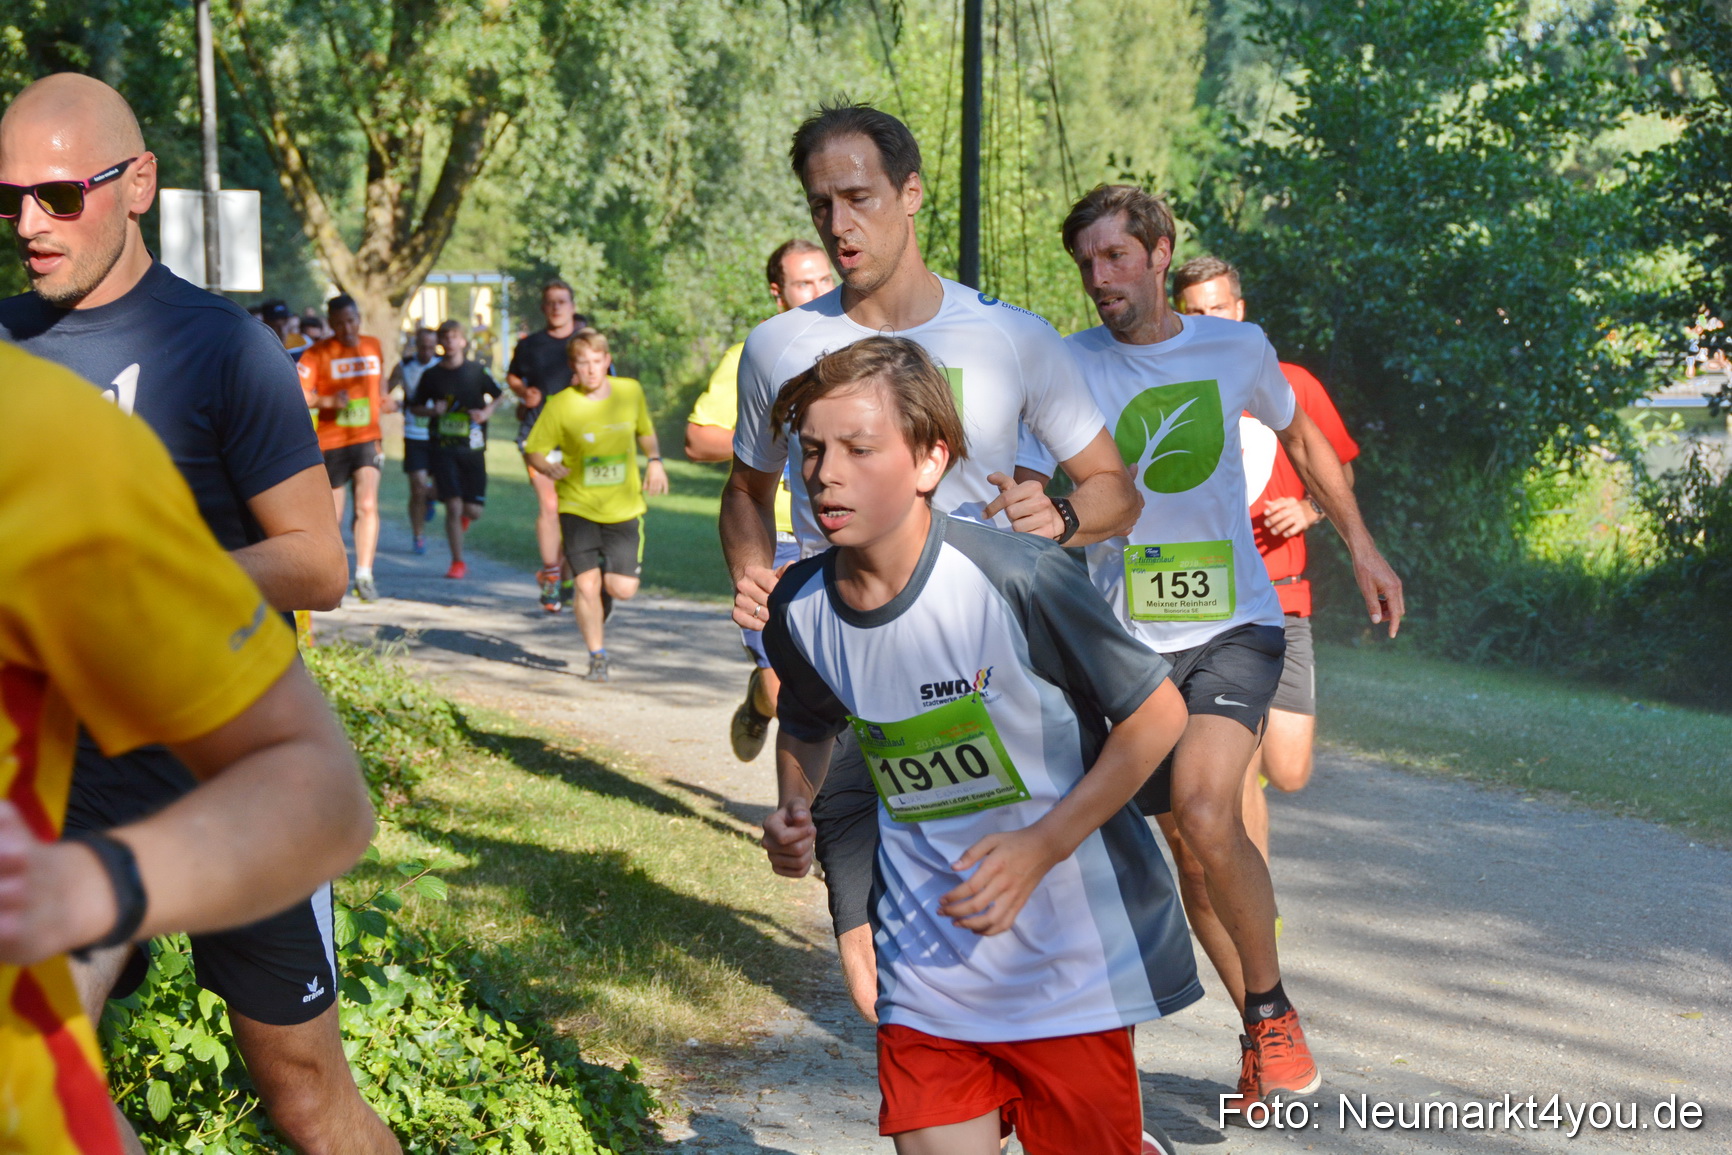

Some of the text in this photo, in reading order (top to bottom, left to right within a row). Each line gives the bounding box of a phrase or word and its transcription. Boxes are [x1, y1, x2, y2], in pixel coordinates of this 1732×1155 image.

[592, 465, 617, 478] 921
[1150, 570, 1210, 599] 153
[1146, 599, 1217, 608] Meixner Reinhard
[879, 743, 990, 793] 1910
[971, 791, 996, 801] Energie
[996, 785, 1016, 794] GmbH
